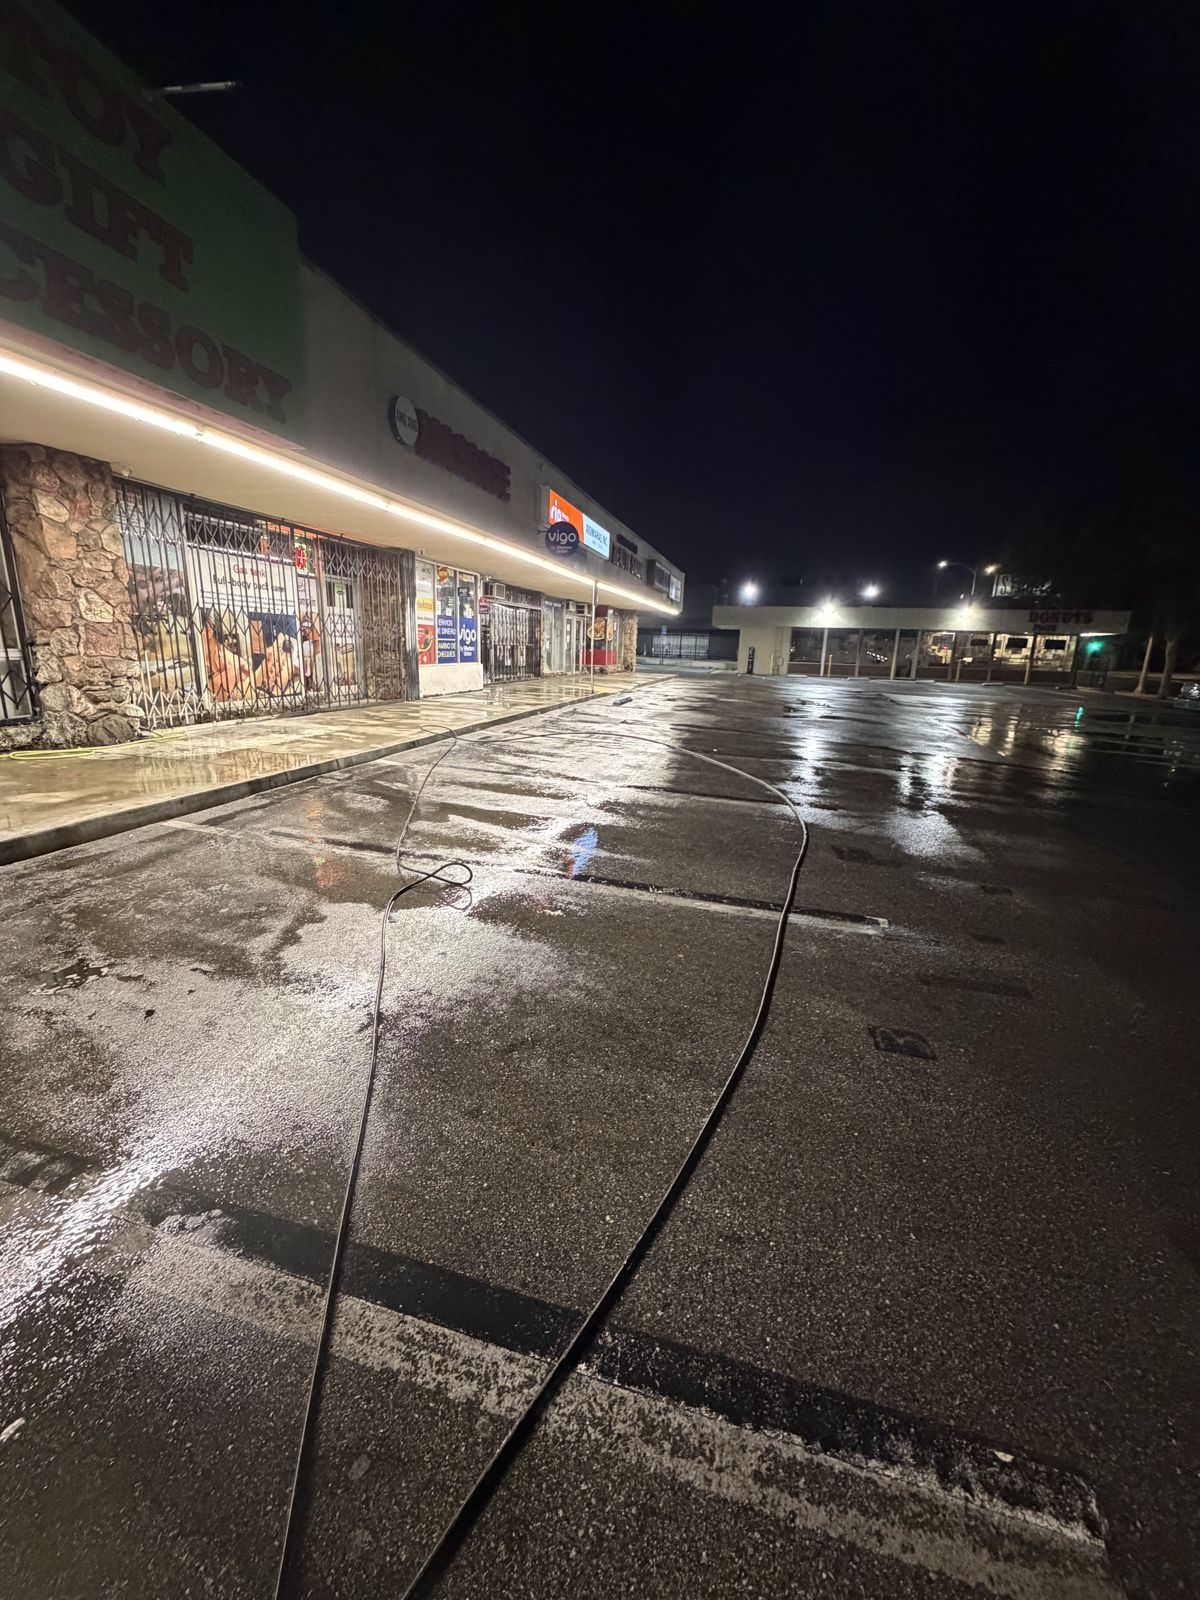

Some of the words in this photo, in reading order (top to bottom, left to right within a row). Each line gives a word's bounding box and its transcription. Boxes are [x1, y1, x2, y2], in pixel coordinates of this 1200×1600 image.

[0, 104, 194, 293] GIFT
[549, 530, 576, 544] vigo
[233, 564, 247, 575] Gas
[1029, 611, 1093, 623] DONUTS
[459, 624, 476, 644] vigo
[437, 641, 450, 649] AMBIO
